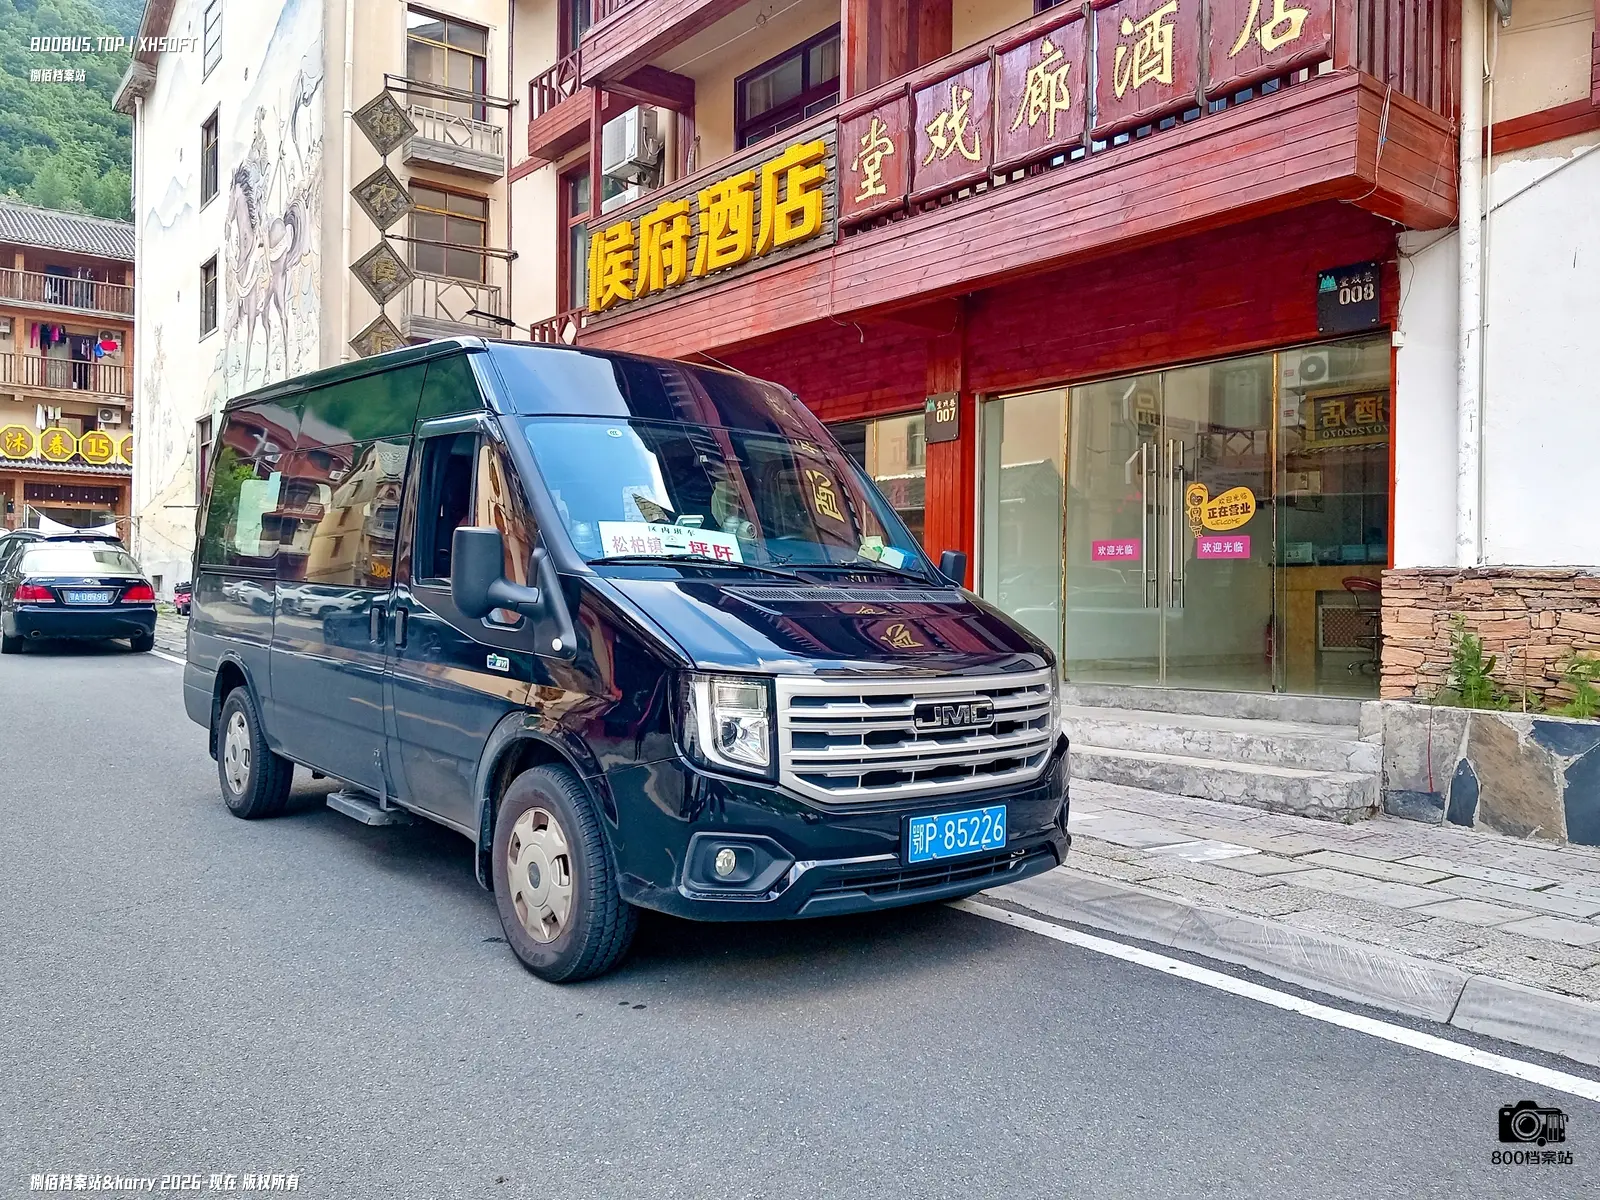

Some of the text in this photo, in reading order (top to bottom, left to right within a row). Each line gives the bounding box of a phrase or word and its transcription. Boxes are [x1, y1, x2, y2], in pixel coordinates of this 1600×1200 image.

[588, 140, 826, 313] 候府酒店
[1339, 283, 1375, 305] 008
[936, 407, 956, 423] 007
[1207, 502, 1251, 520] 正在营业
[1097, 544, 1134, 556] 欢迎光临
[1202, 541, 1244, 553] 欢迎光临
[916, 704, 993, 727] JMC
